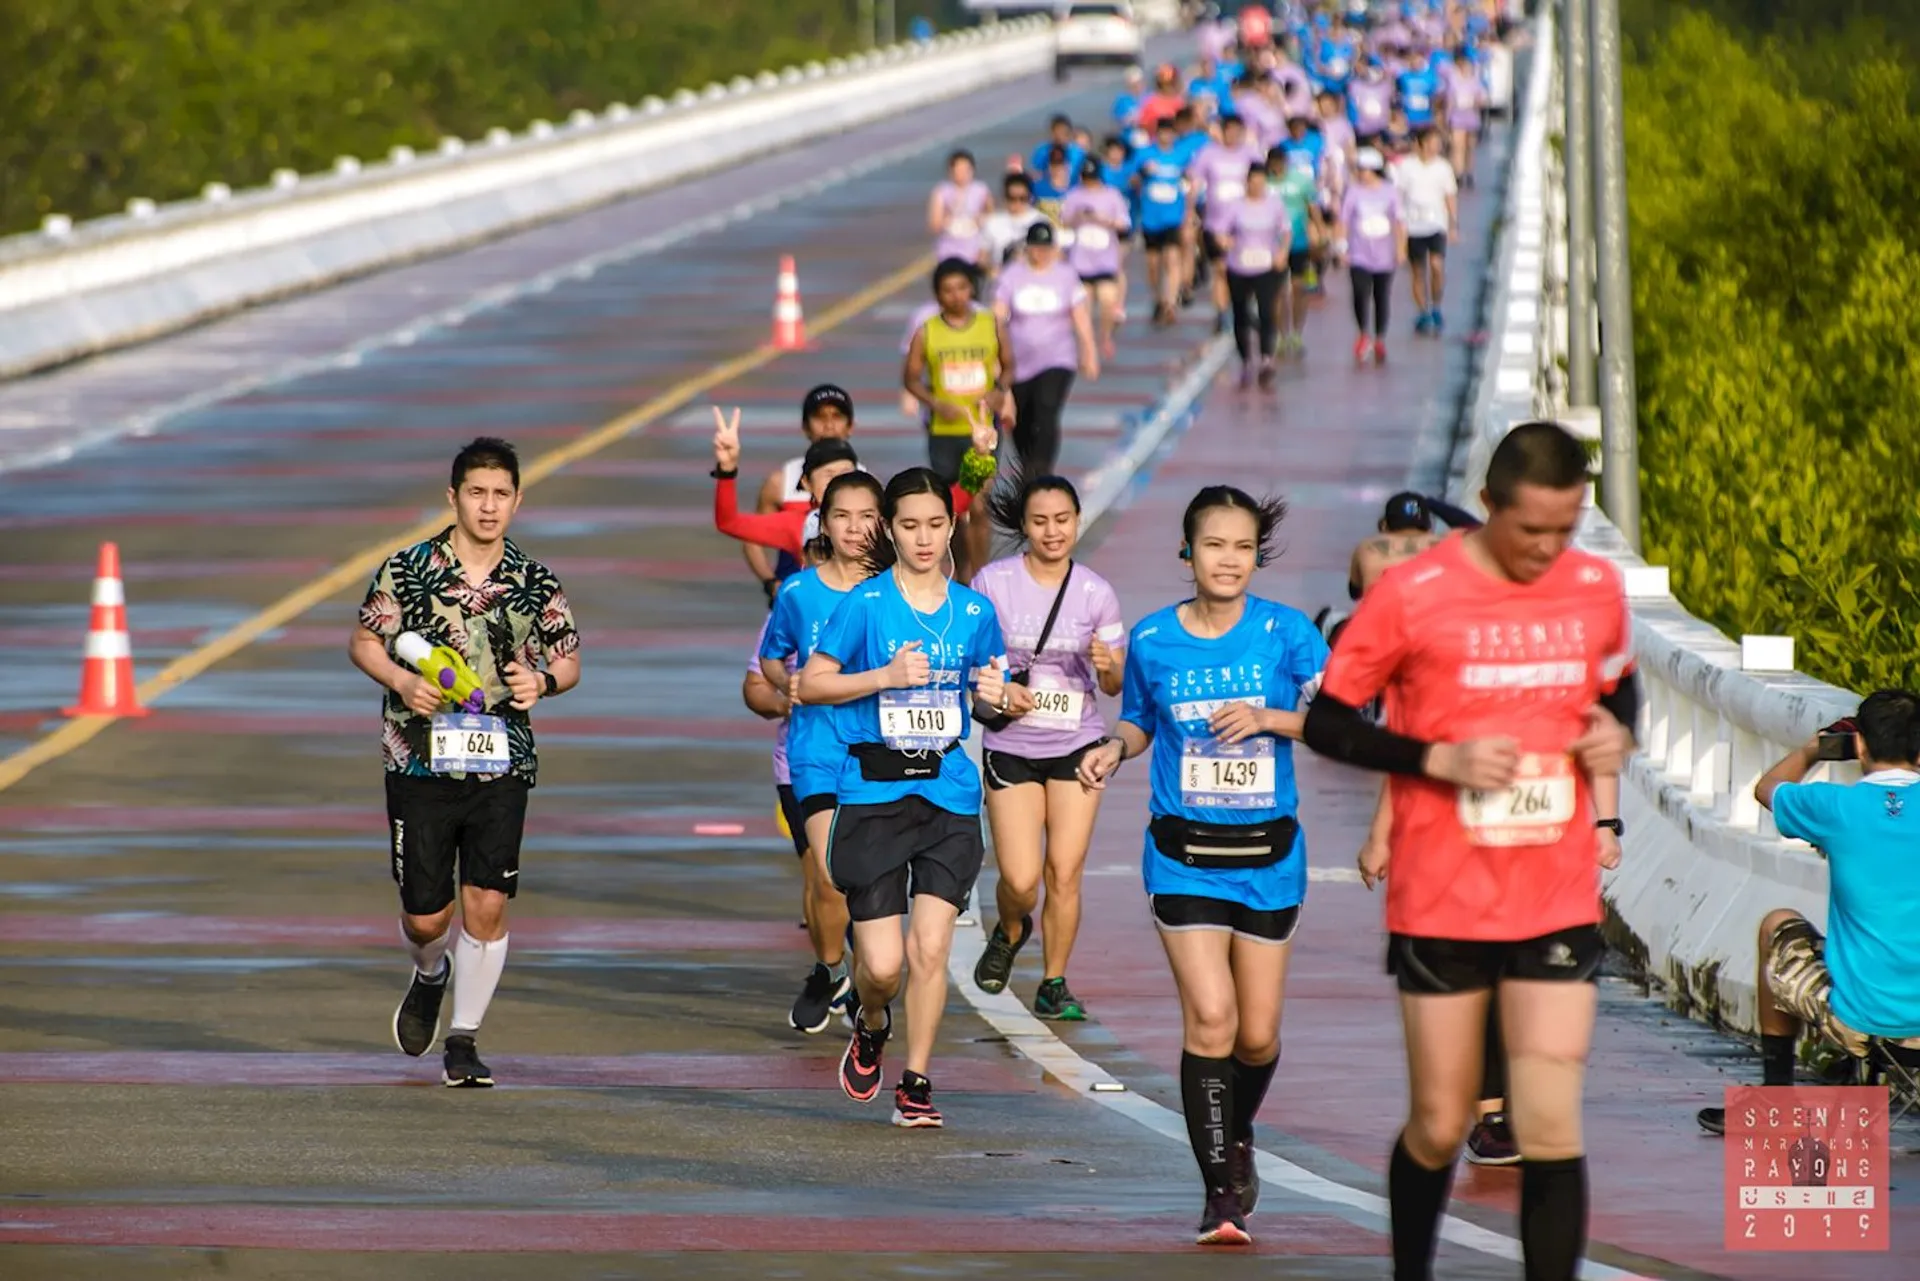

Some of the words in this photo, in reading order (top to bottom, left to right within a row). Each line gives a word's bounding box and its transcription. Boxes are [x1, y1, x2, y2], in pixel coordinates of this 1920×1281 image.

[1170, 664, 1262, 687] SCENIC
[1034, 691, 1069, 713] 3498
[907, 709, 945, 731] 1610
[1190, 764, 1199, 774] F
[1212, 761, 1258, 786] 1439
[1509, 783, 1552, 815] 264
[1201, 1078, 1227, 1164] Kalenji
